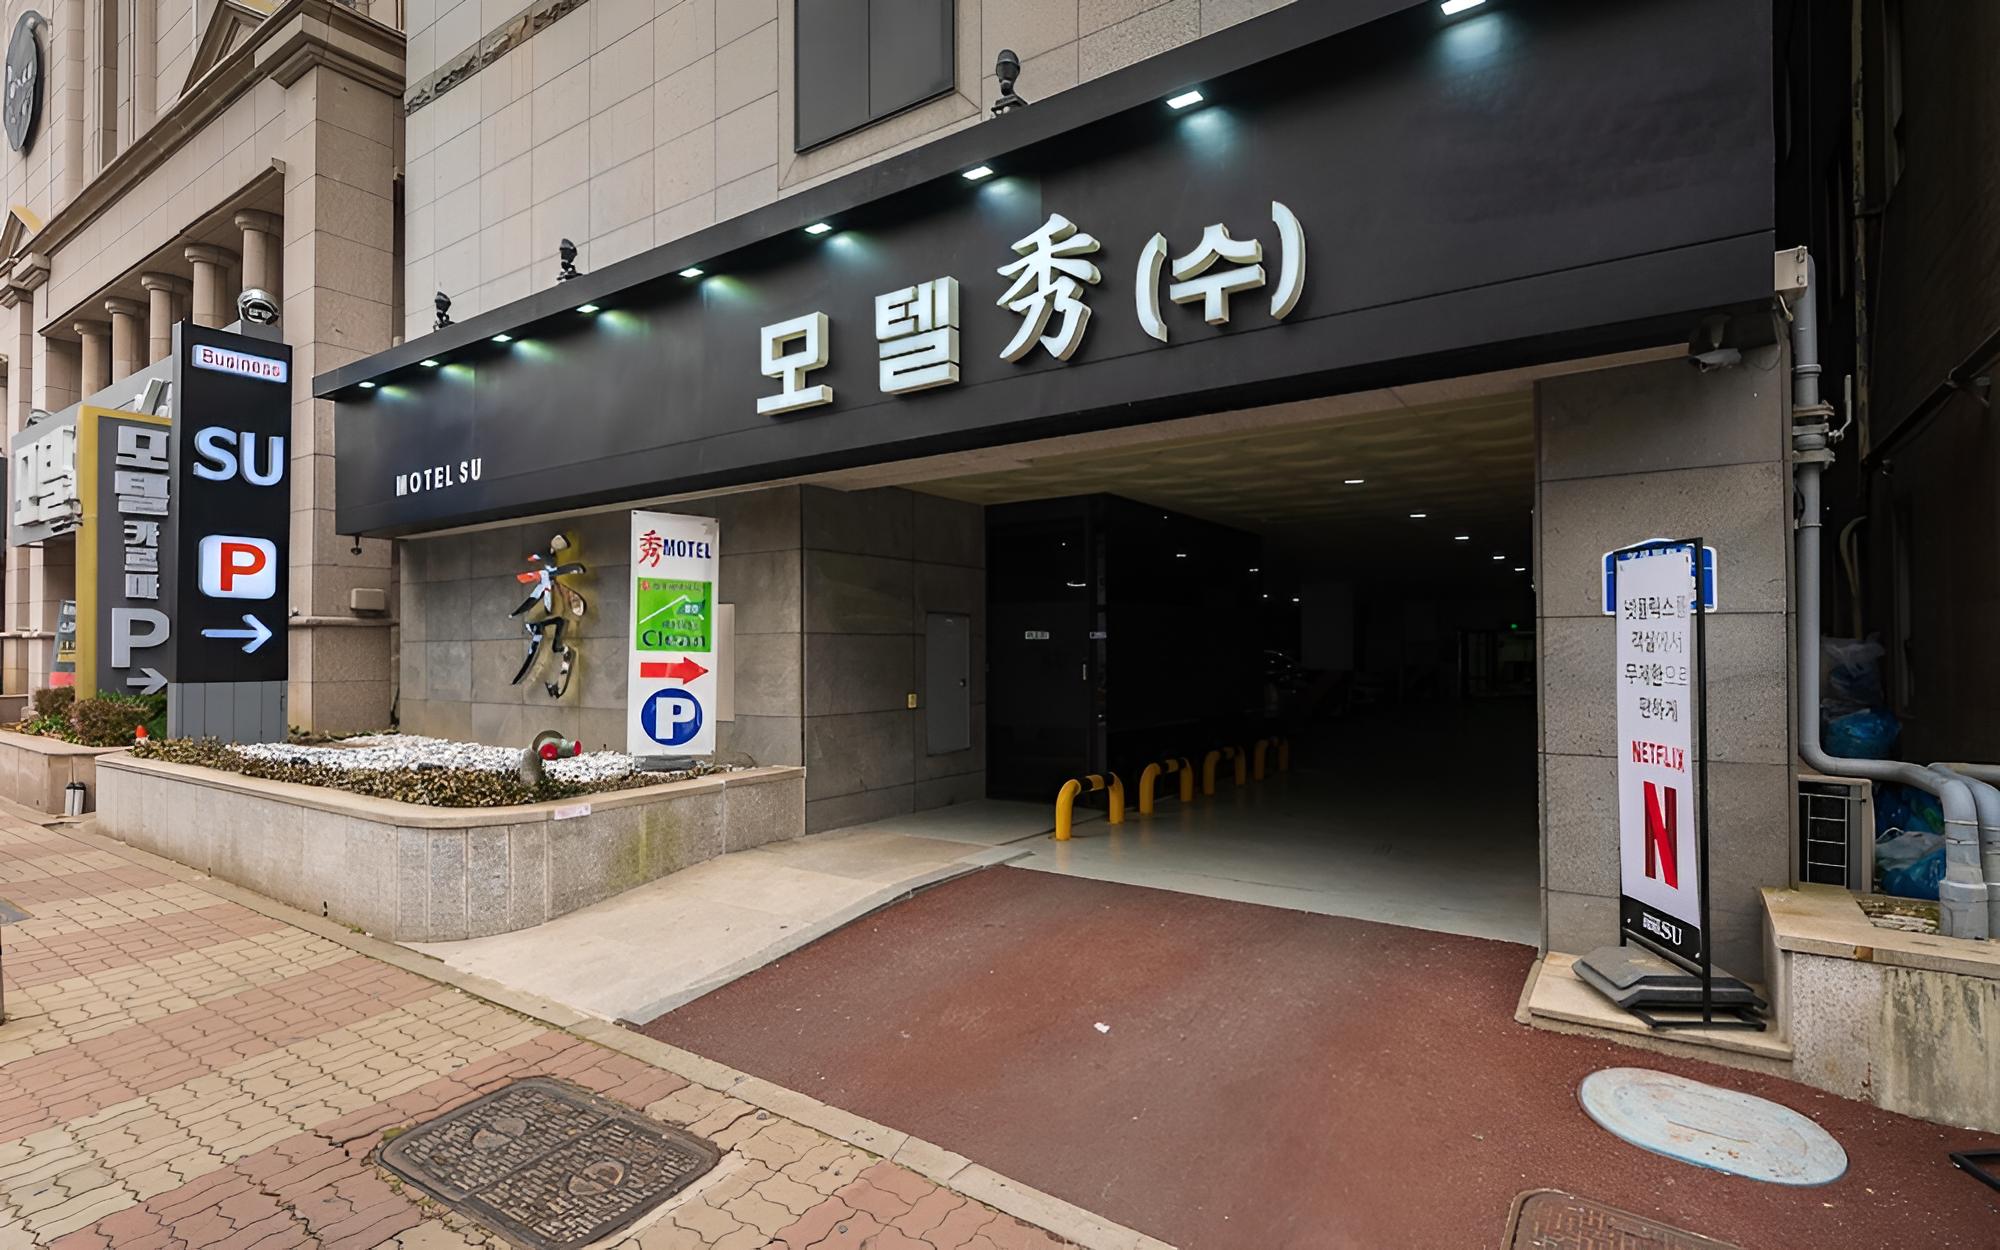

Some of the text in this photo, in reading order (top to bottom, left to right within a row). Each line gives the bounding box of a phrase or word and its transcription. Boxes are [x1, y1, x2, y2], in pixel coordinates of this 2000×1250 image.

[193, 426, 284, 486] SU
[396, 457, 482, 497] MOTEL SU
[220, 542, 266, 591] P
[662, 538, 712, 560] MOTEL
[111, 607, 170, 668] P
[655, 696, 696, 740] P
[1632, 740, 1685, 773] NETFLIX
[1643, 781, 1678, 890] N
